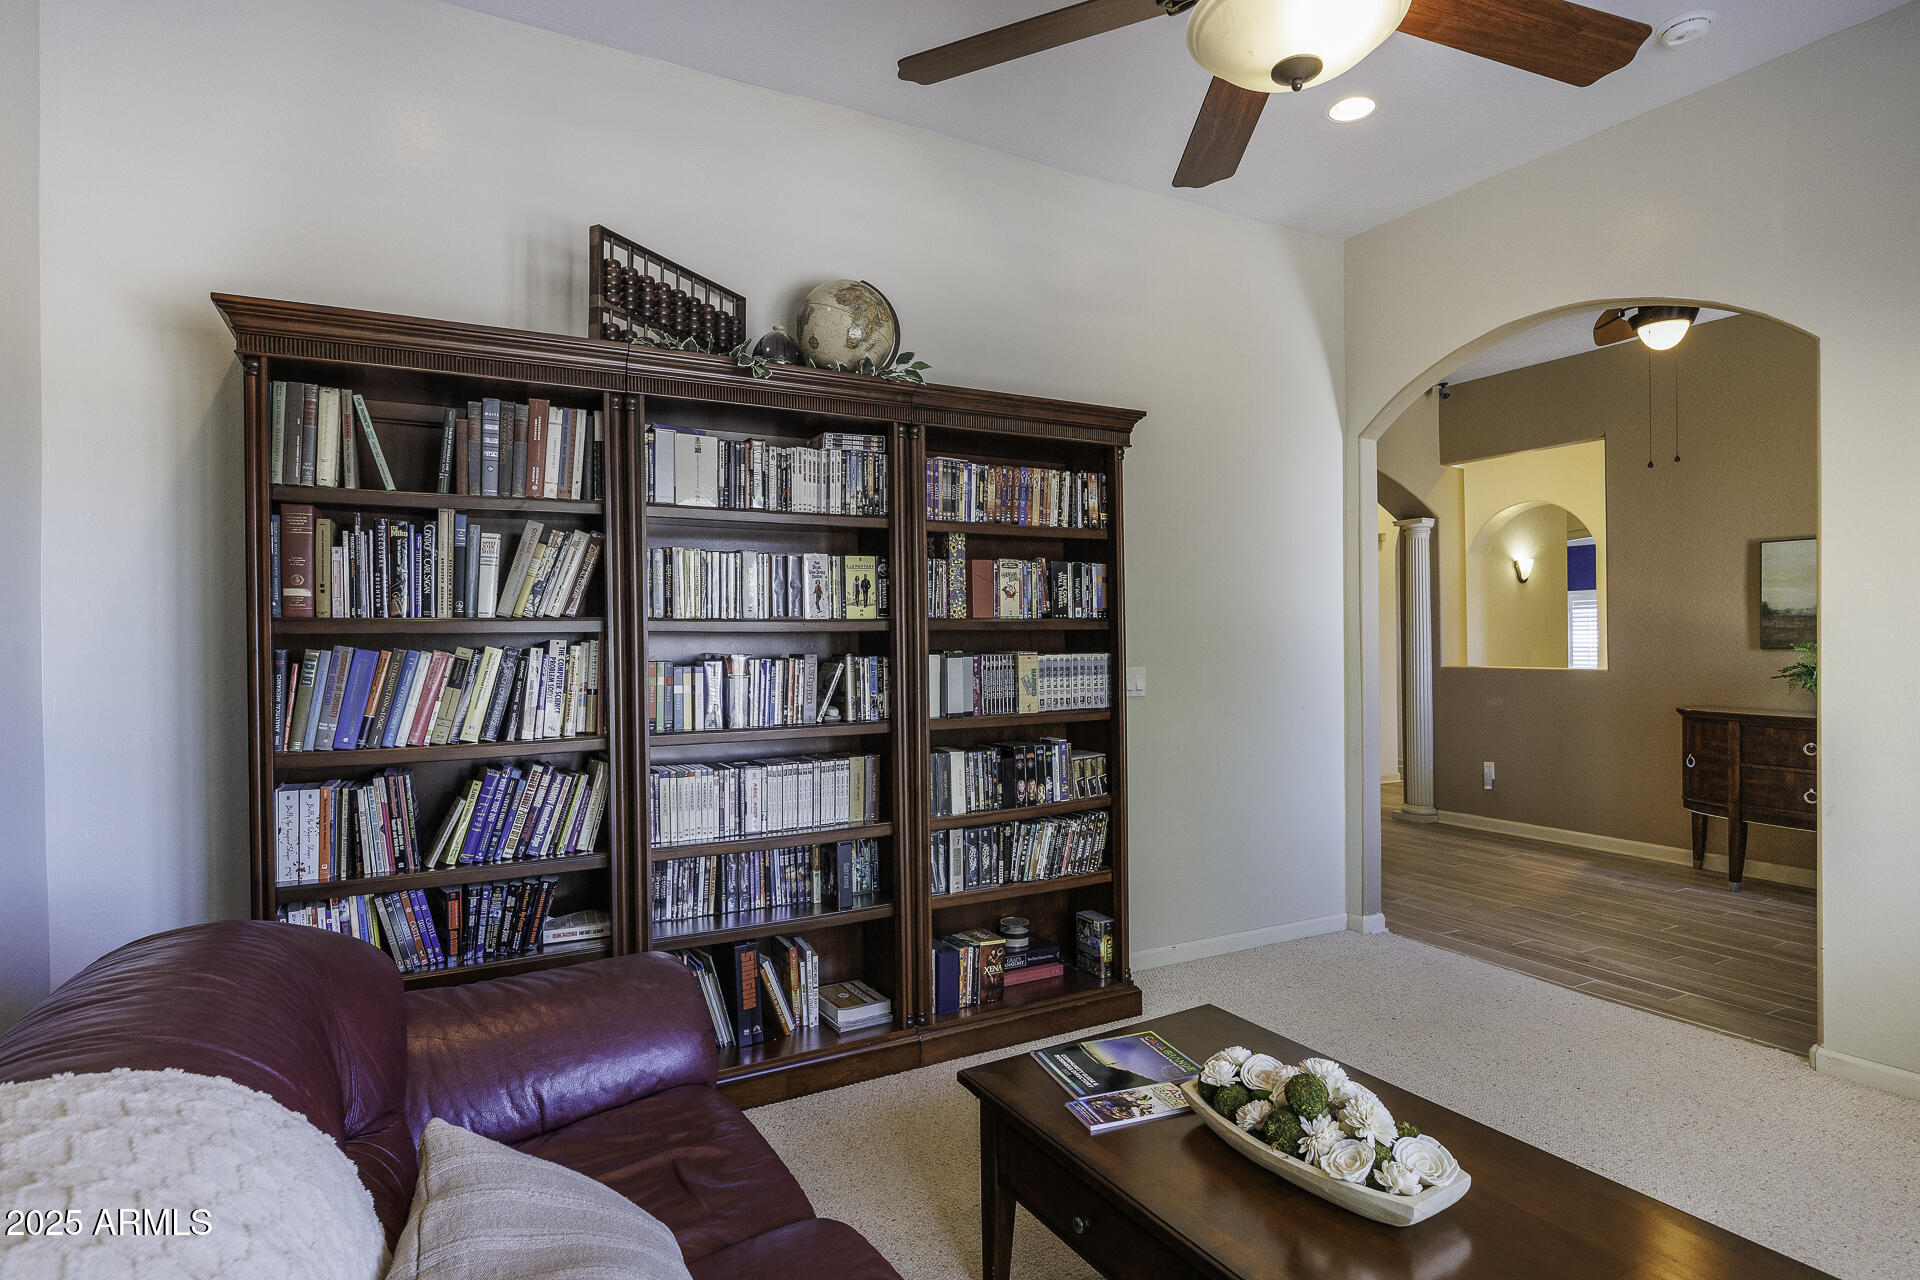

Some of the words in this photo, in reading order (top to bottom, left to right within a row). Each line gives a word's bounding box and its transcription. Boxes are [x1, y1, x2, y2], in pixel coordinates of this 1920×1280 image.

[424, 574, 432, 594] SAGAN
[806, 661, 816, 704] JUSTIFIED
[1144, 1036, 1166, 1051] CASA
[1163, 1049, 1197, 1071] GRANDE
